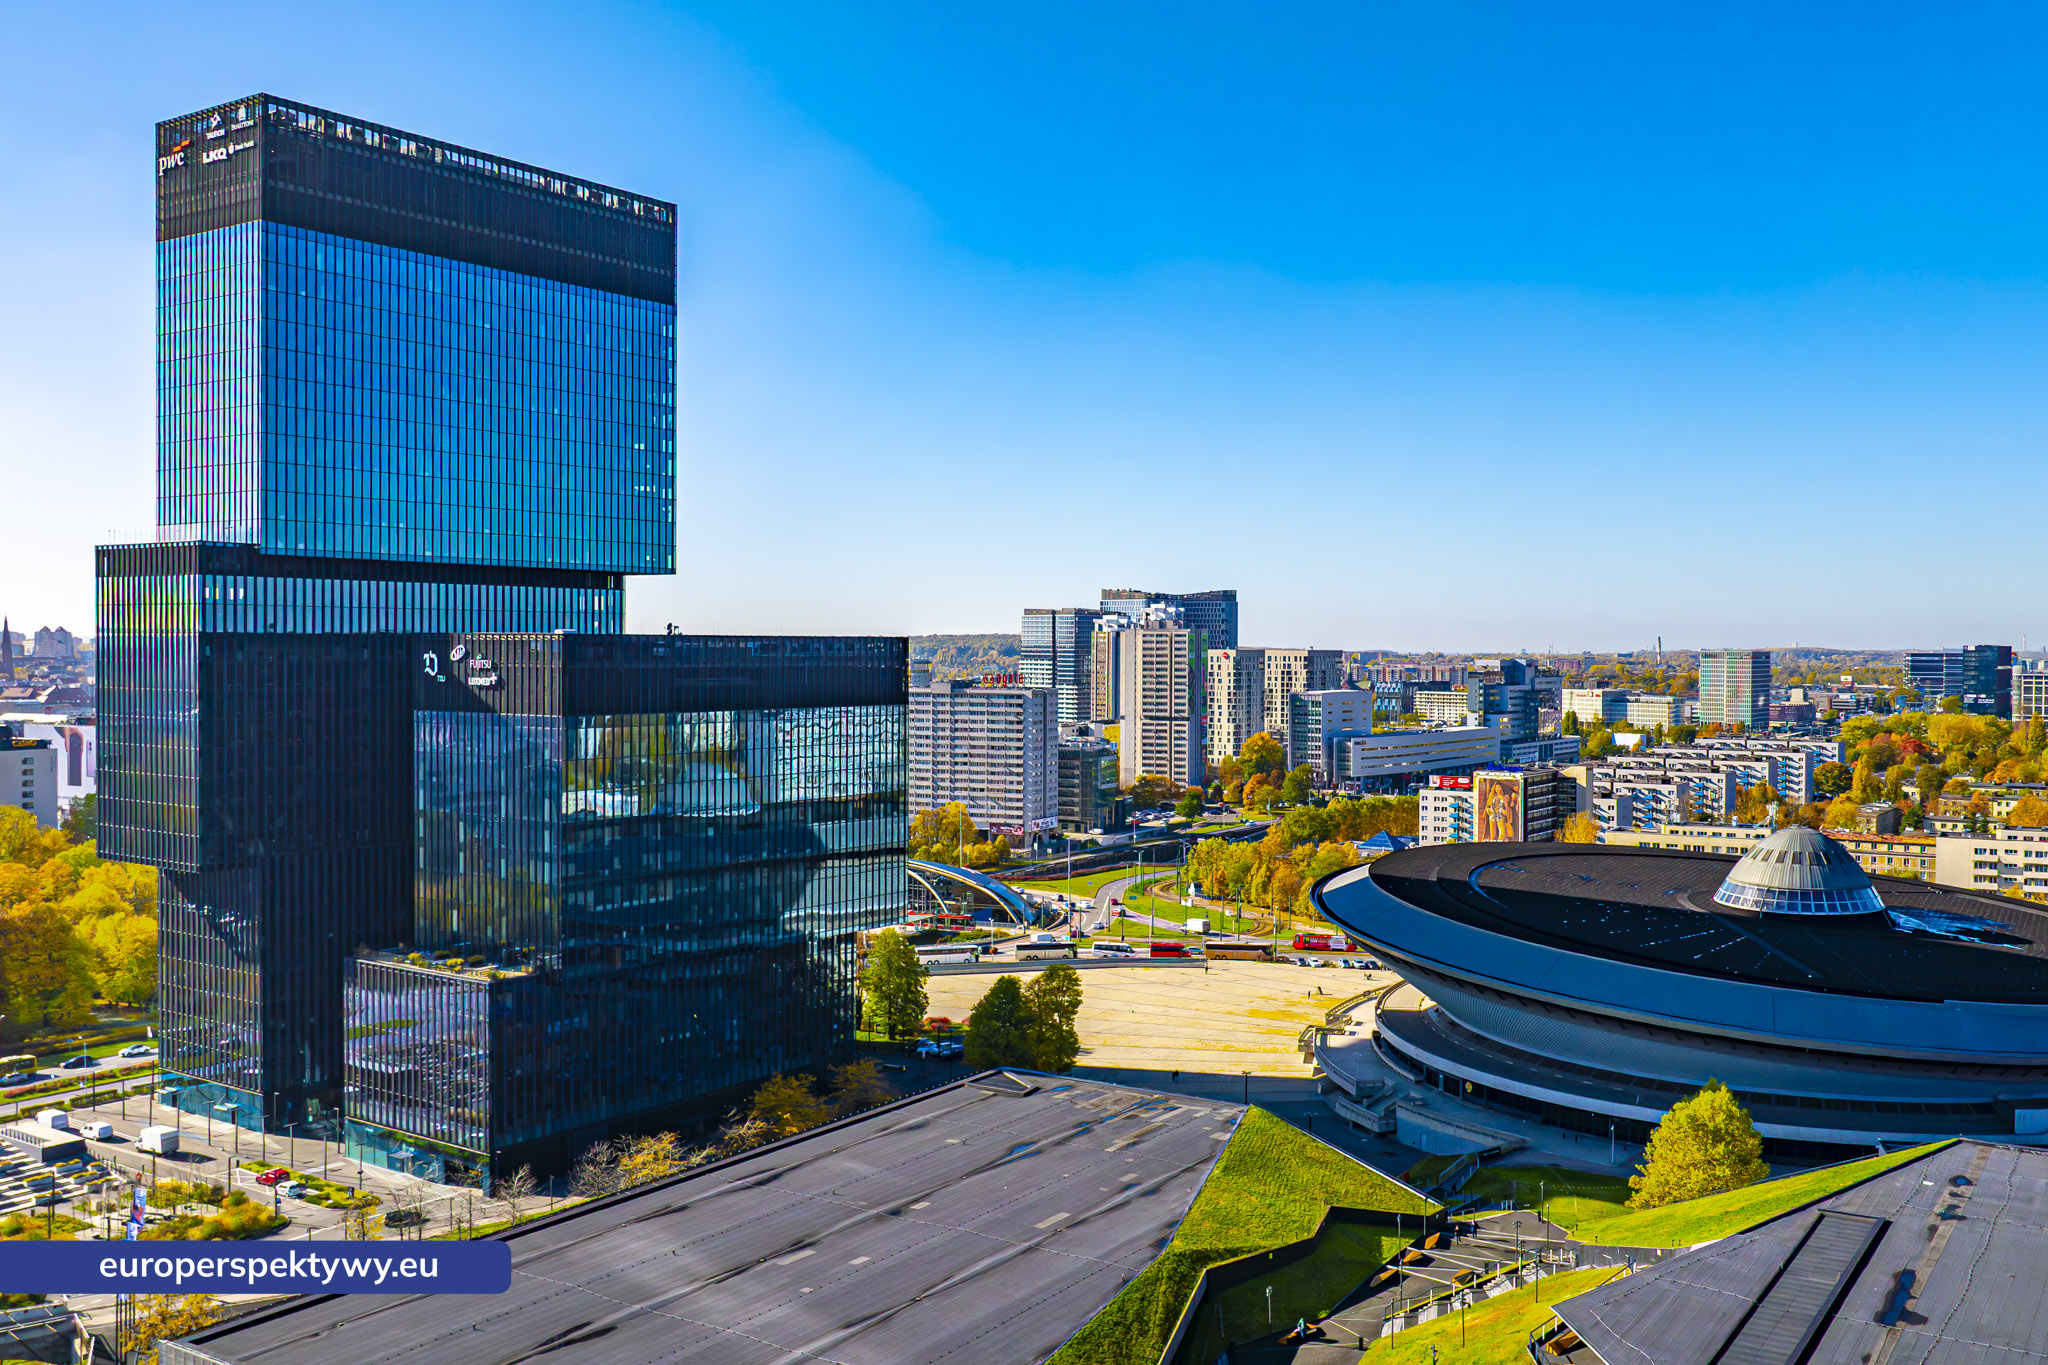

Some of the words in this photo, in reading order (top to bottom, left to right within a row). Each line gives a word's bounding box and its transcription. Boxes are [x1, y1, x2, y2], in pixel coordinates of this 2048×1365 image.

[202, 147, 228, 164] LKQ
[469, 659, 492, 670] FUJITSU
[996, 672, 1024, 687] agata
